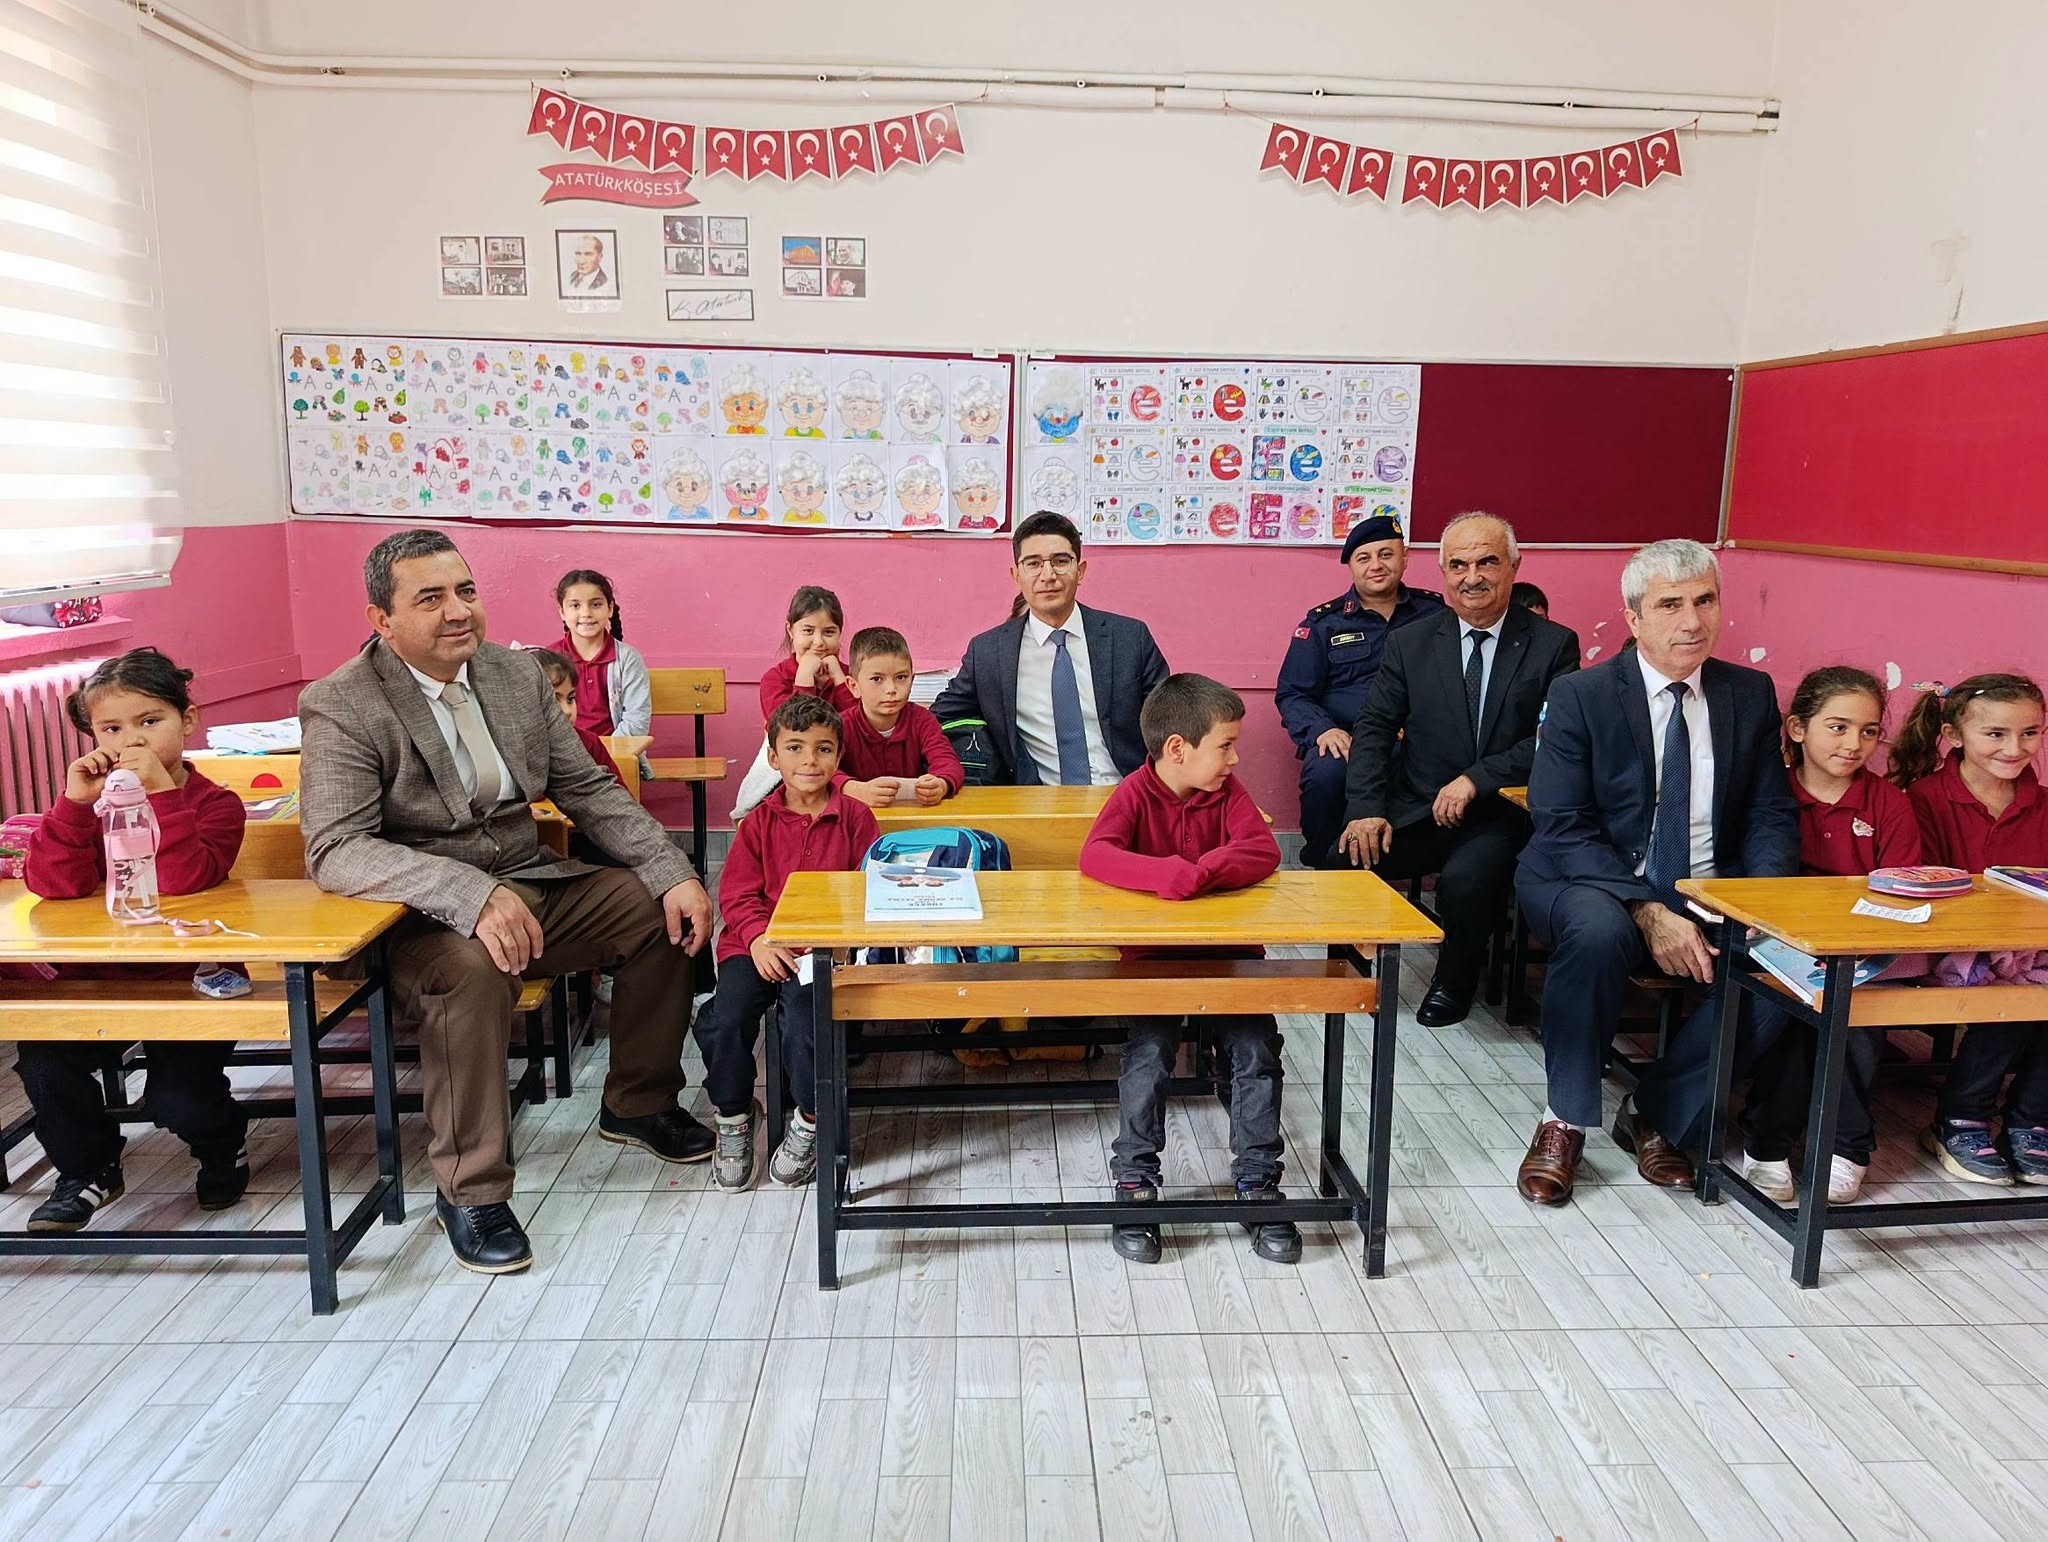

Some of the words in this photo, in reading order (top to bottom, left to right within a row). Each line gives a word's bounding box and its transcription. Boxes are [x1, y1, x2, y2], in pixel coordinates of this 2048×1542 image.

[304, 375, 316, 390] A
[325, 382, 333, 390] a
[365, 376, 377, 391] A
[386, 383, 394, 392] a
[425, 378, 437, 393] A
[446, 385, 454, 393] a
[486, 380, 498, 395] A
[507, 388, 515, 396] a
[547, 383, 560, 397] A
[568, 390, 576, 398] a
[608, 385, 620, 400] A
[629, 393, 637, 401] a
[668, 388, 680, 403] A
[689, 395, 697, 403] a
[1130, 385, 1162, 421] e
[1213, 384, 1246, 421] e
[1294, 385, 1328, 423] e
[1377, 385, 1412, 424] e
[1128, 444, 1162, 481] e
[1210, 444, 1243, 480] e
[1252, 436, 1286, 480] E
[1290, 444, 1322, 481] e
[1374, 446, 1407, 482] e
[310, 462, 322, 477] A
[330, 468, 338, 477] a
[368, 464, 381, 477] A
[389, 469, 397, 478] a
[429, 465, 441, 479] A
[449, 471, 457, 480] a
[489, 466, 502, 481] A
[510, 472, 518, 481] a
[549, 467, 562, 482] A
[570, 474, 578, 482] a
[610, 469, 622, 484] A
[630, 476, 638, 484] a
[1127, 503, 1160, 540] e
[1209, 502, 1240, 538] e
[1250, 493, 1282, 539] E
[1287, 502, 1320, 538] e
[1133, 1191, 1149, 1199] NIKE
